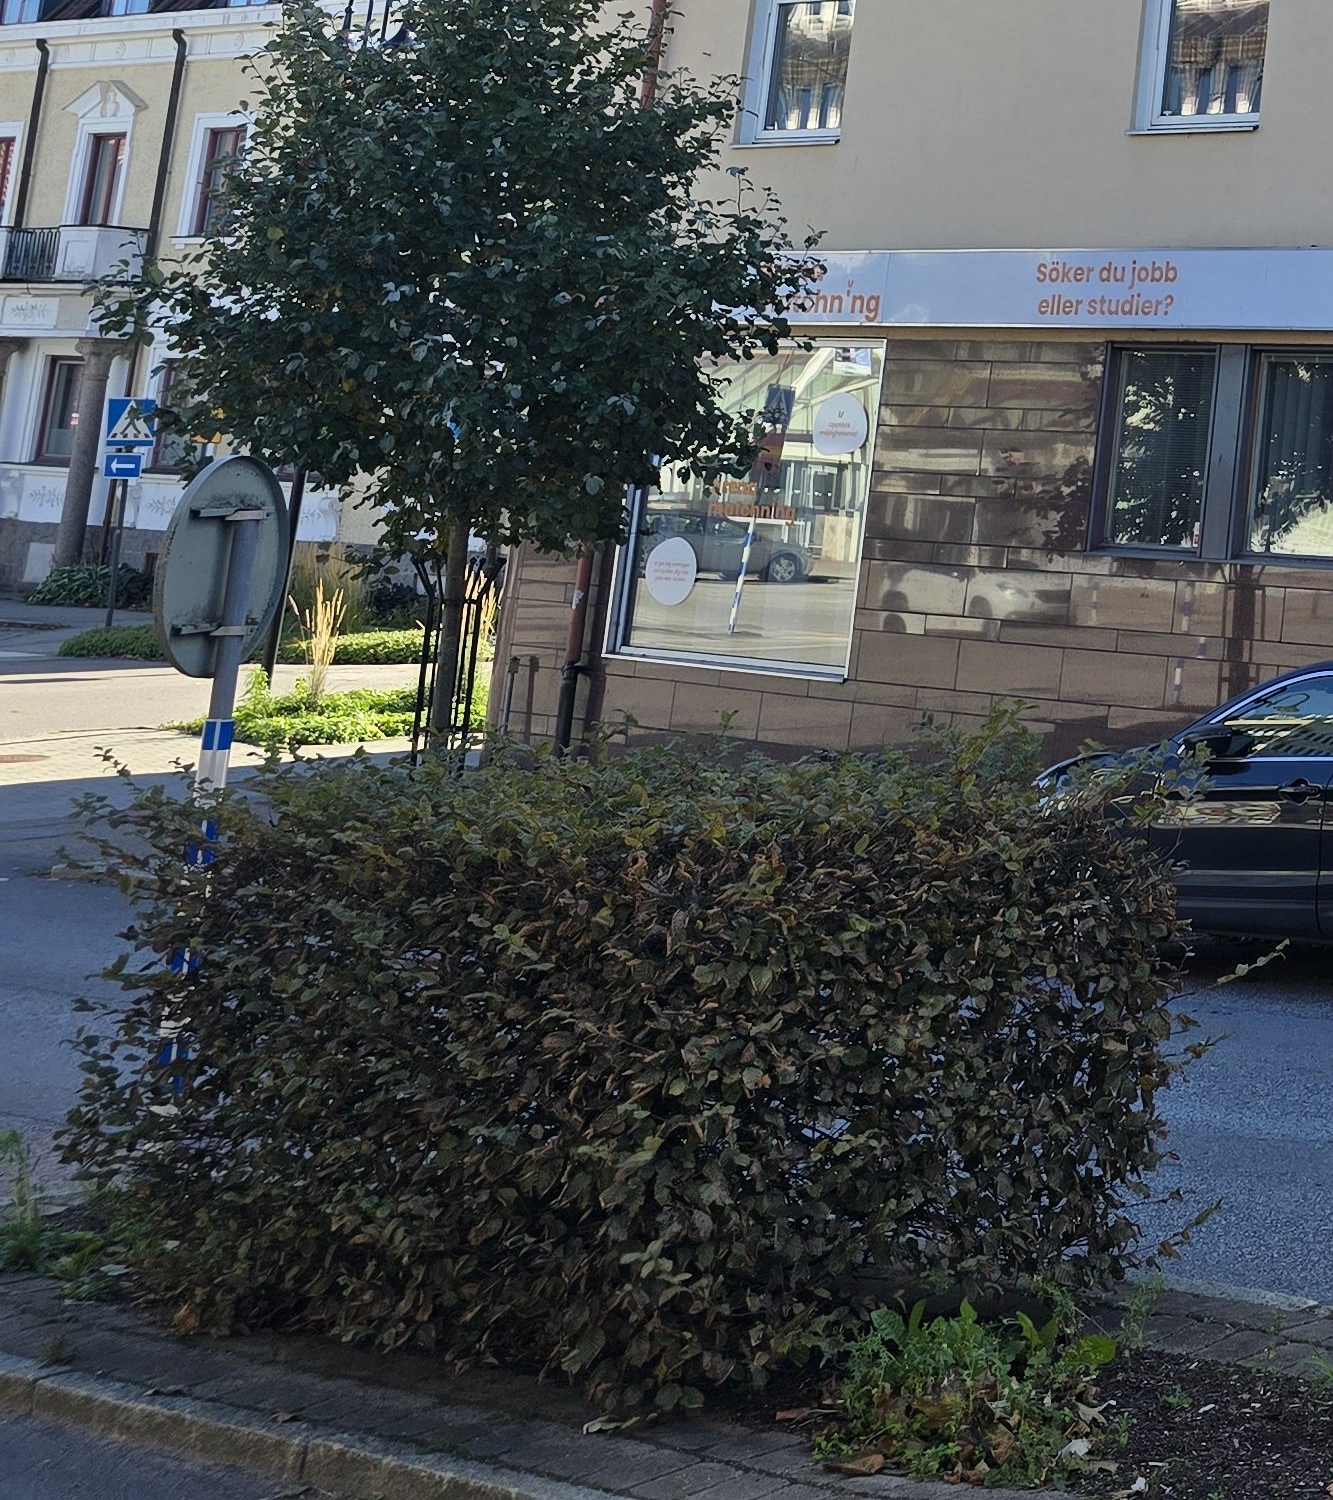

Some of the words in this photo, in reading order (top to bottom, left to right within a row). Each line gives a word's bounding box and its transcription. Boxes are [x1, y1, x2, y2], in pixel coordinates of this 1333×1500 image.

[1036, 261, 1094, 283] Söker
[1098, 261, 1126, 283] du
[1128, 259, 1178, 290] jobb
[1037, 294, 1083, 316] eller
[1087, 292, 1174, 317] studier?
